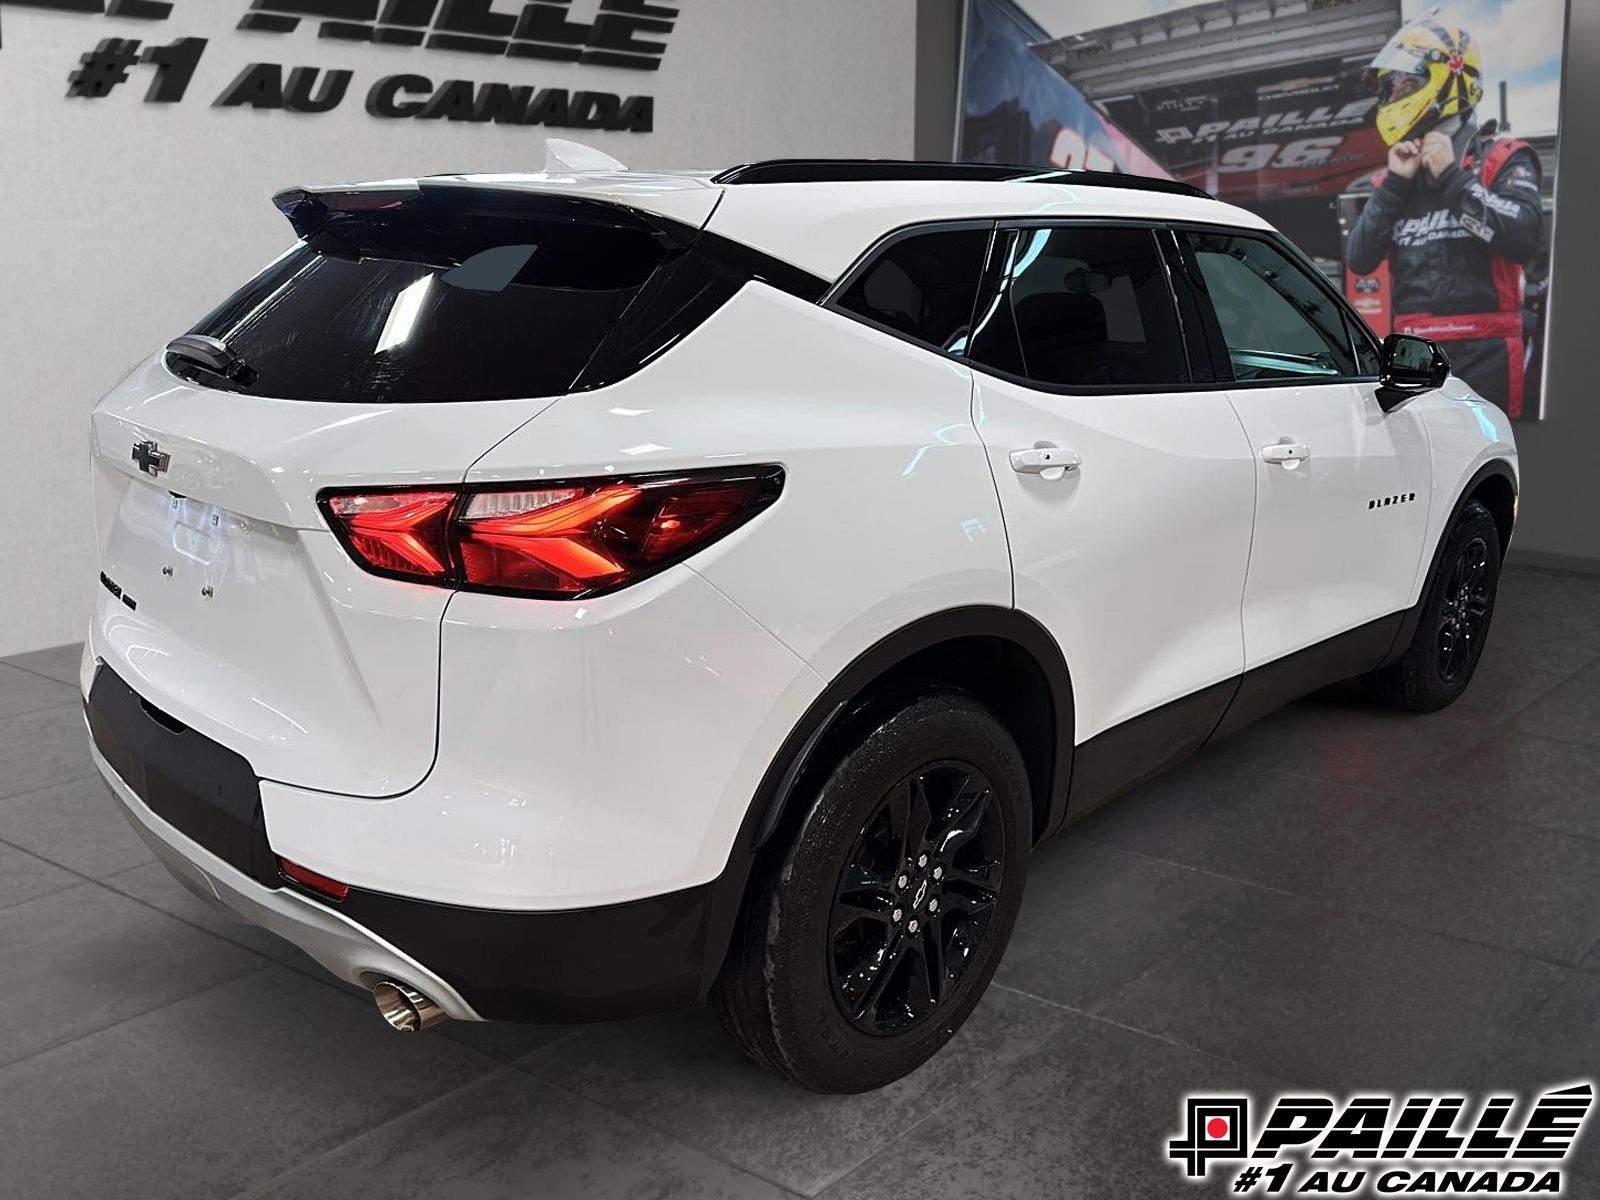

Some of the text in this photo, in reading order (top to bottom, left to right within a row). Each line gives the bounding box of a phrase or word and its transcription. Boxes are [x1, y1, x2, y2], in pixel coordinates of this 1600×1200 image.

[65, 37, 654, 133] #1 AU CANADA
[1223, 131, 1255, 141] AU
[1262, 117, 1364, 136] CANADA
[1218, 136, 1345, 174] 96
[1368, 493, 1416, 509] BLAZER
